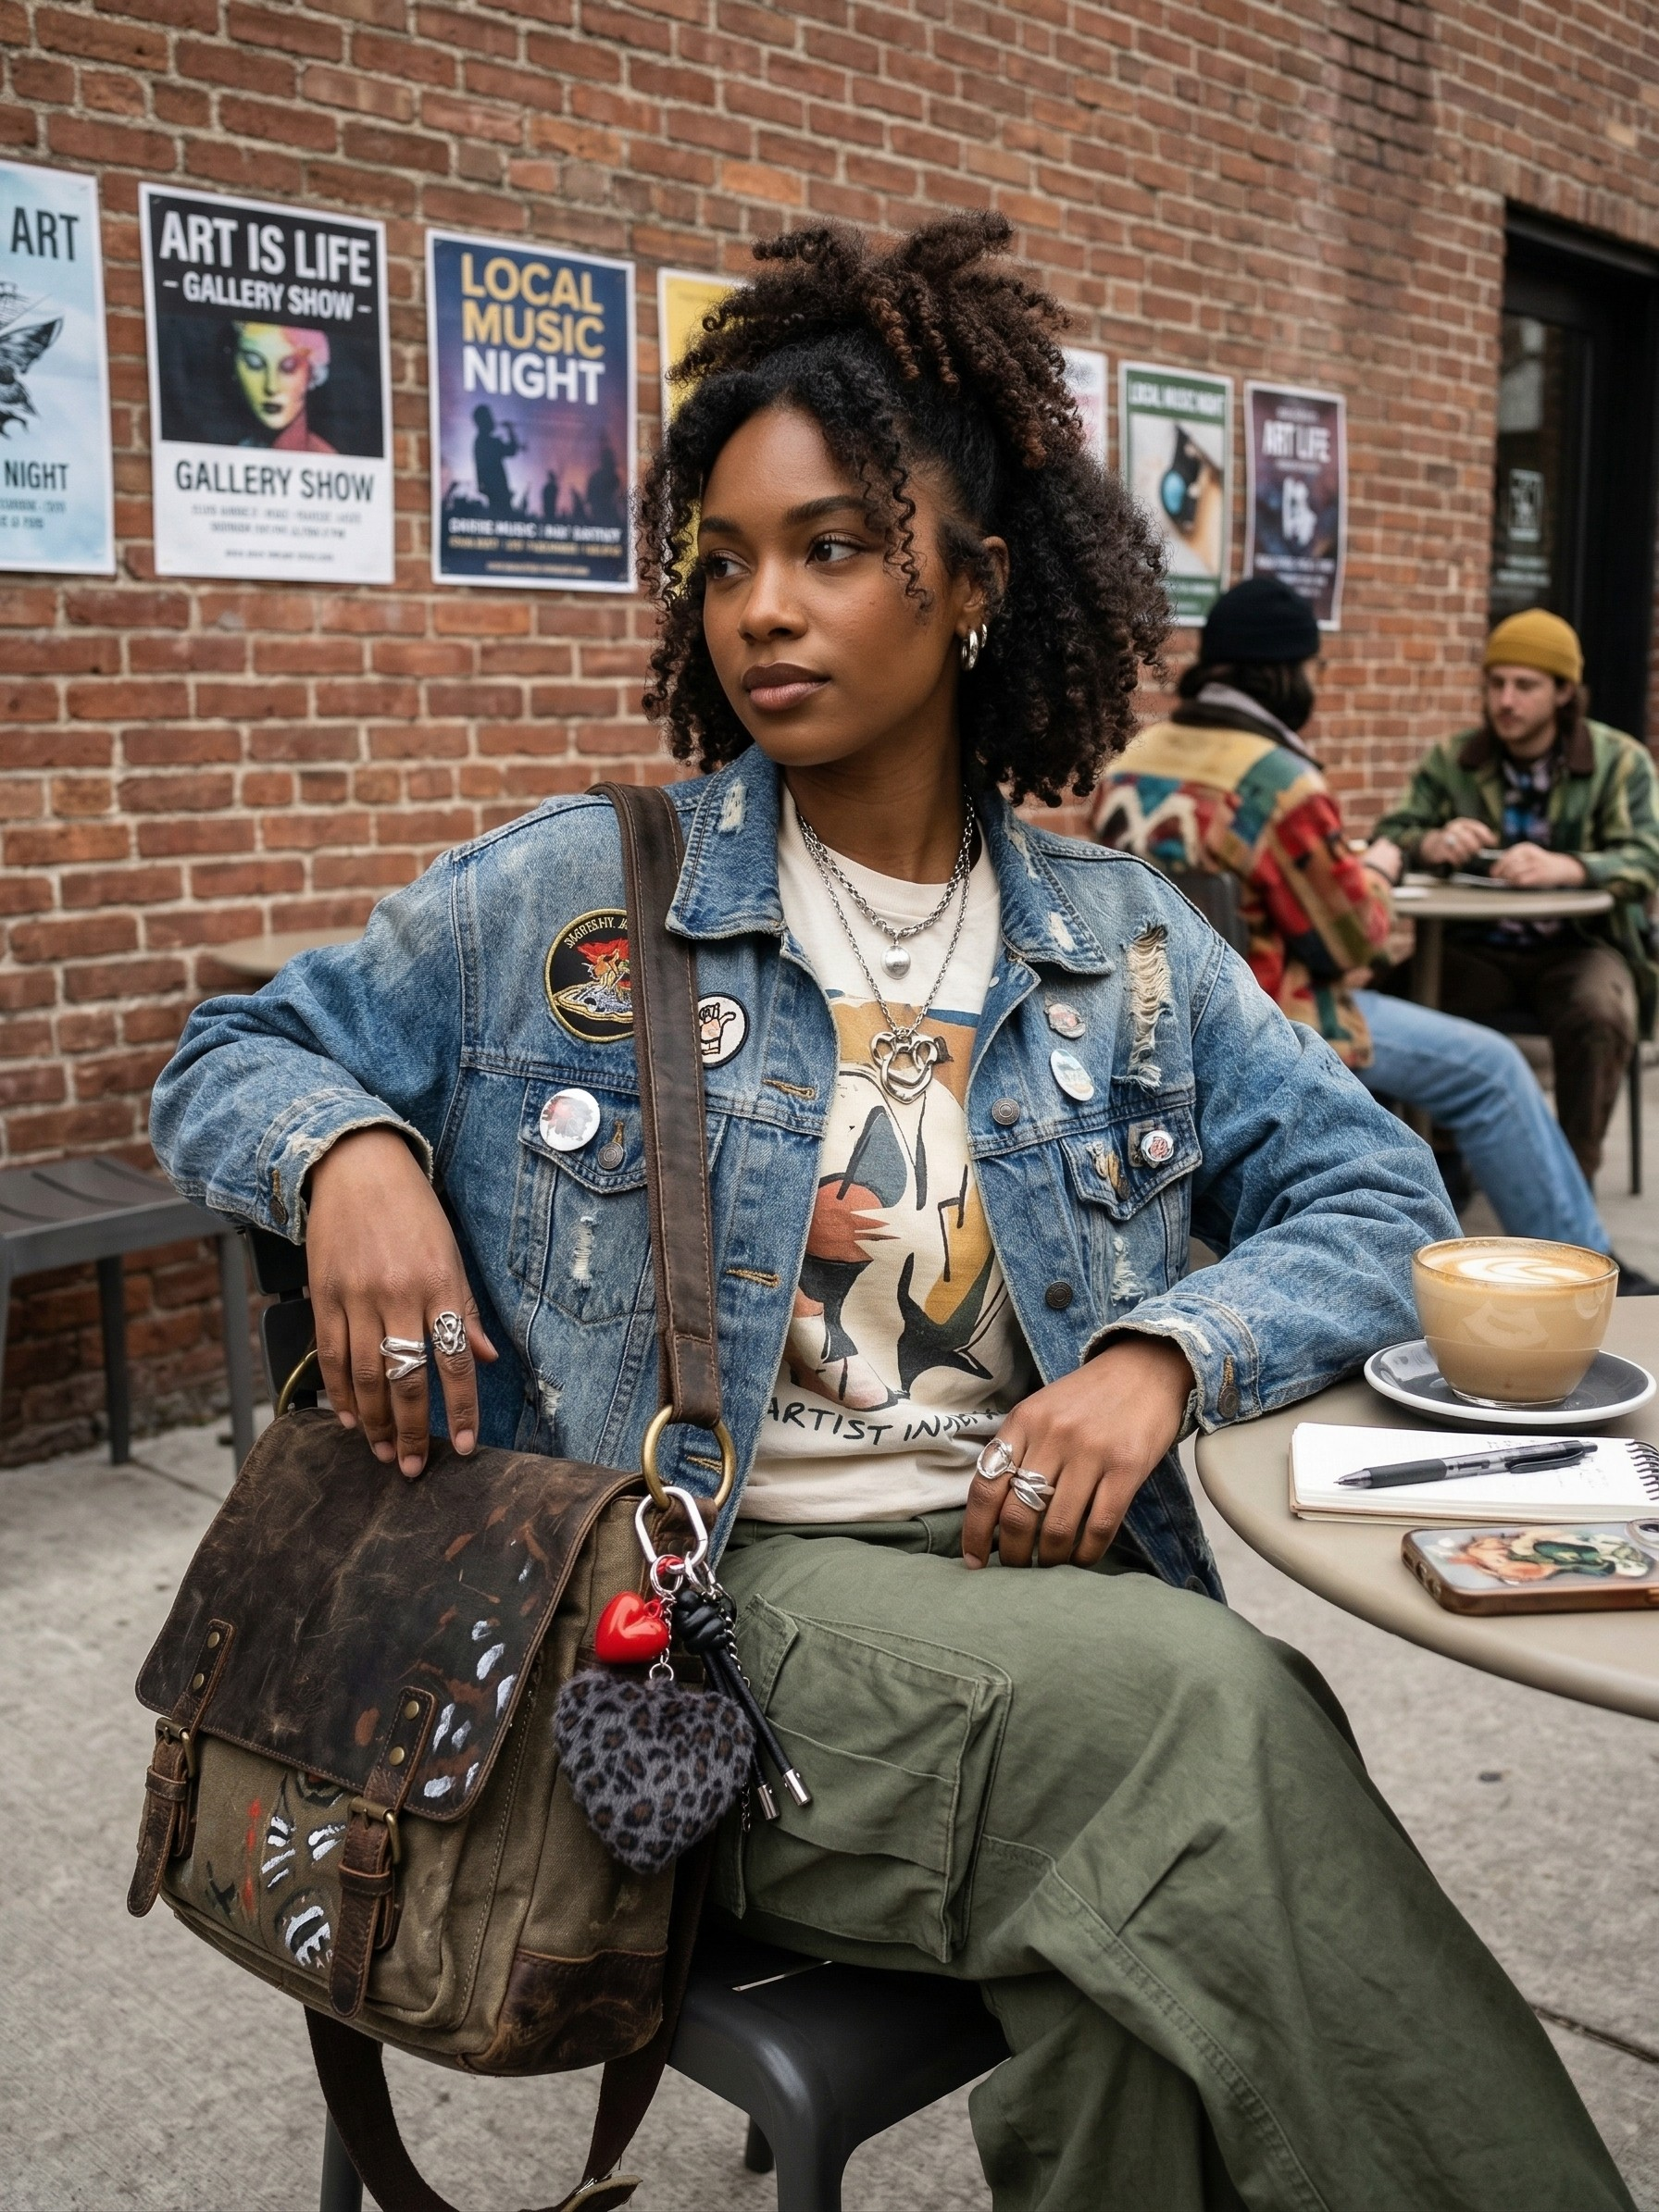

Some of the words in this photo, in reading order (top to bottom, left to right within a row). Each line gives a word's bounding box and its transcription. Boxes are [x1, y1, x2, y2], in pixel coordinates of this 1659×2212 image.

[11, 206, 80, 262] ART
[159, 210, 239, 268] ART
[247, 222, 286, 276] IS
[295, 229, 372, 288] LIFE
[461, 251, 604, 316] LOCAL
[462, 302, 606, 359] MUSIC
[462, 345, 606, 406] NIGHT
[5, 459, 69, 491] NIGHT
[176, 460, 293, 497] GALLERY
[300, 469, 375, 503] SHOW
[767, 1397, 893, 1446] ARTIST
